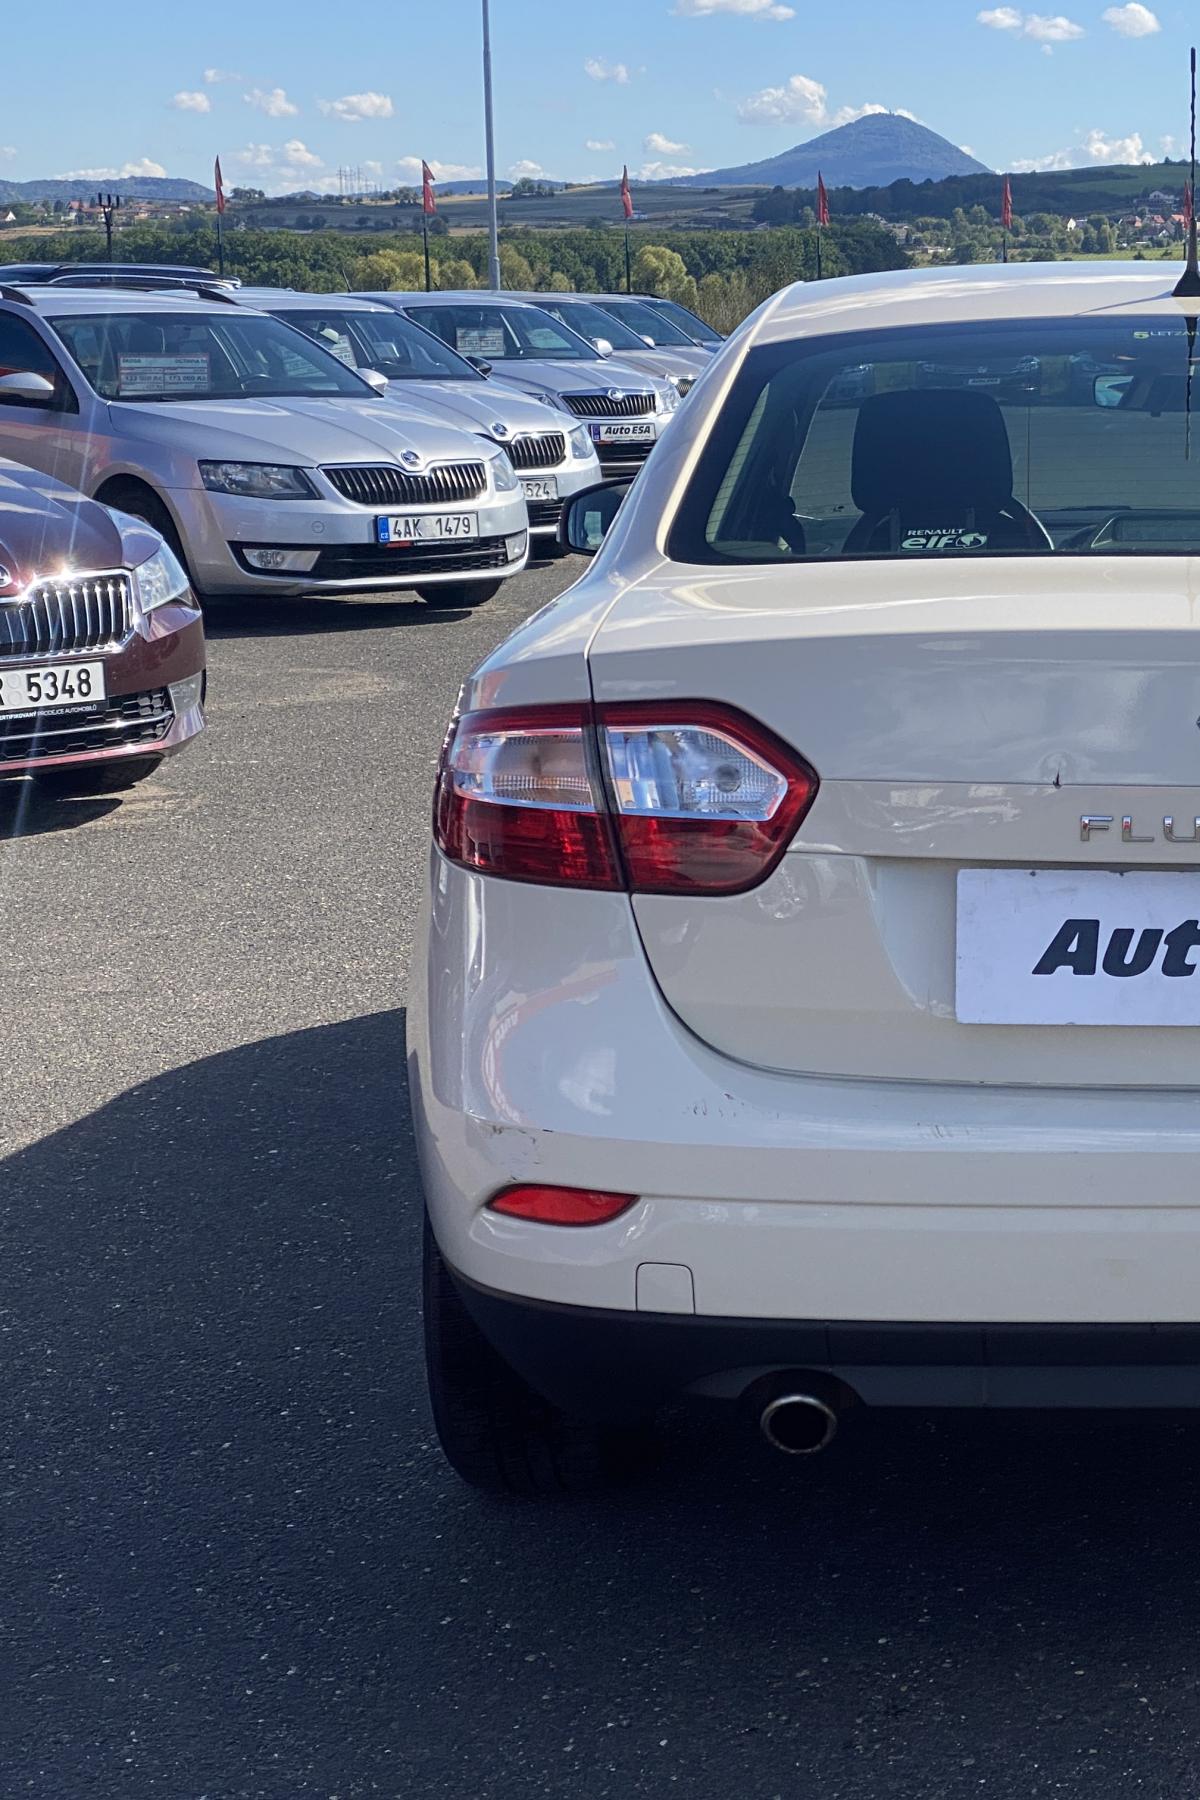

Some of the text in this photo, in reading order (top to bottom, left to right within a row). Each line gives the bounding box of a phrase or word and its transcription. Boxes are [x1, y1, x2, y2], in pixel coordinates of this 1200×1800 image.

[604, 426, 651, 434] Auto ESA
[393, 516, 470, 538] 4AK 1479
[907, 528, 966, 536] RENAULT
[901, 535, 957, 549] elf
[26, 668, 92, 702] 5348
[65, 704, 97, 713] AUTOMOBILŮ
